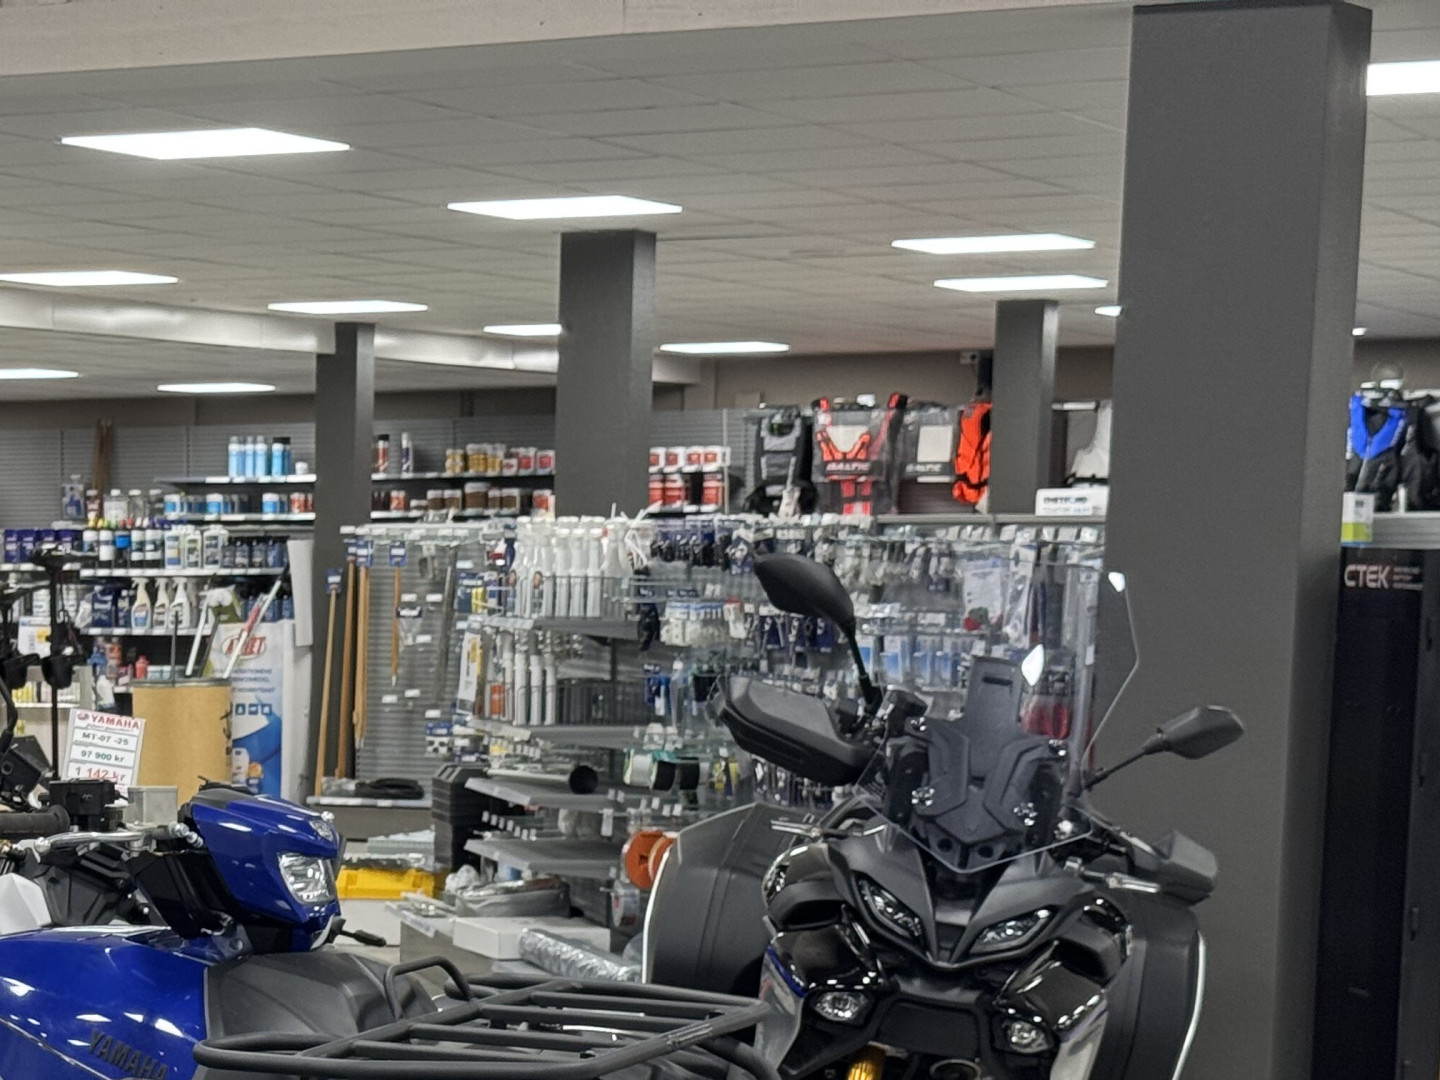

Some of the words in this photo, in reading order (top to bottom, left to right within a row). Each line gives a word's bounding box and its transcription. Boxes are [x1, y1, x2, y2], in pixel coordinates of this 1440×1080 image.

[1344, 564, 1391, 589] CTEK
[91, 714, 139, 730] YAMAHA
[82, 732, 112, 743] MT-07
[95, 752, 112, 761] 900
[114, 754, 124, 763] kr
[75, 766, 81, 776] 1
[87, 767, 109, 779] 142
[113, 771, 127, 781] kr
